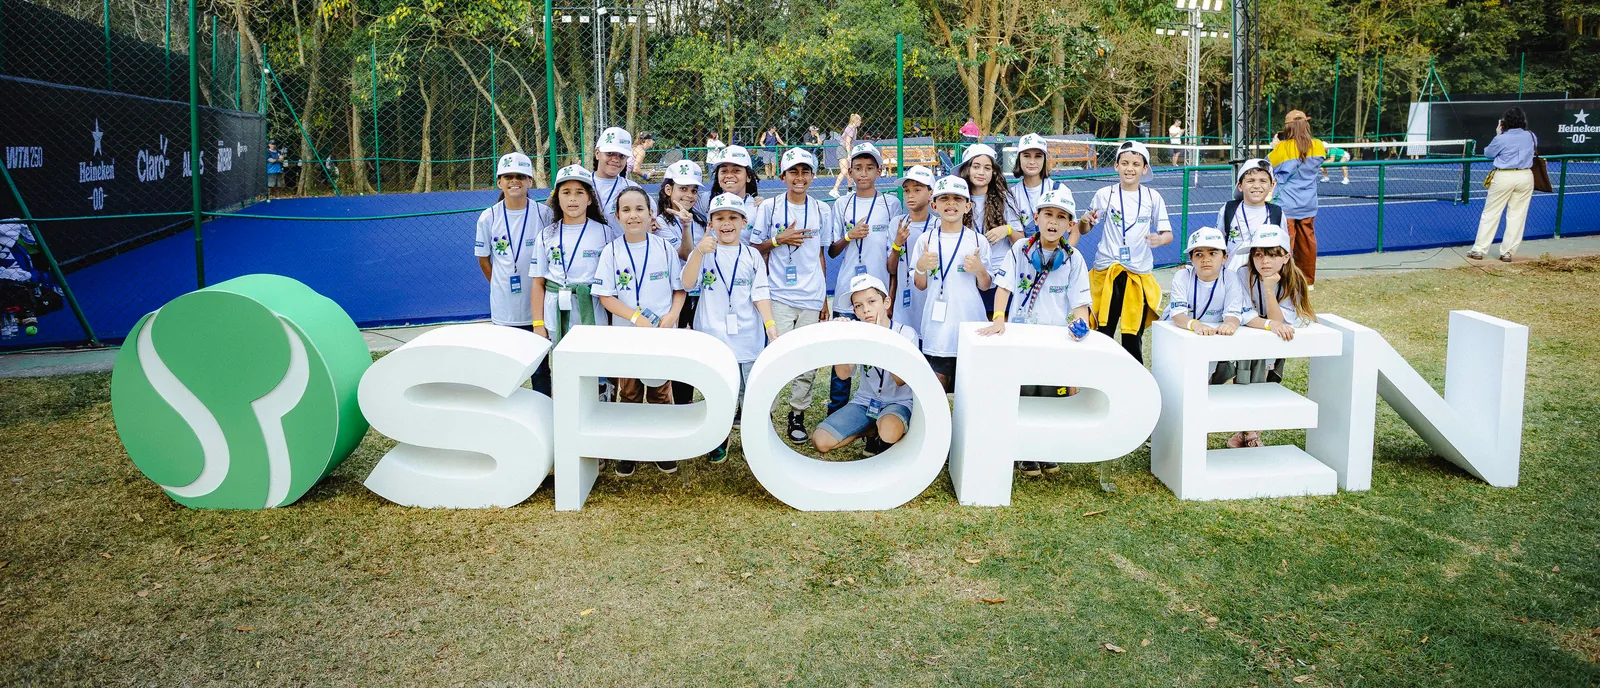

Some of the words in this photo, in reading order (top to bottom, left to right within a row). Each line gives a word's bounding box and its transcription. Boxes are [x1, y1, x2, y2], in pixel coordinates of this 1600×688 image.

[1558, 124, 1600, 133] Heineken
[6, 146, 29, 169] WTA
[30, 146, 43, 168] 250
[137, 149, 166, 182] Claro
[79, 160, 115, 183] Heineken
